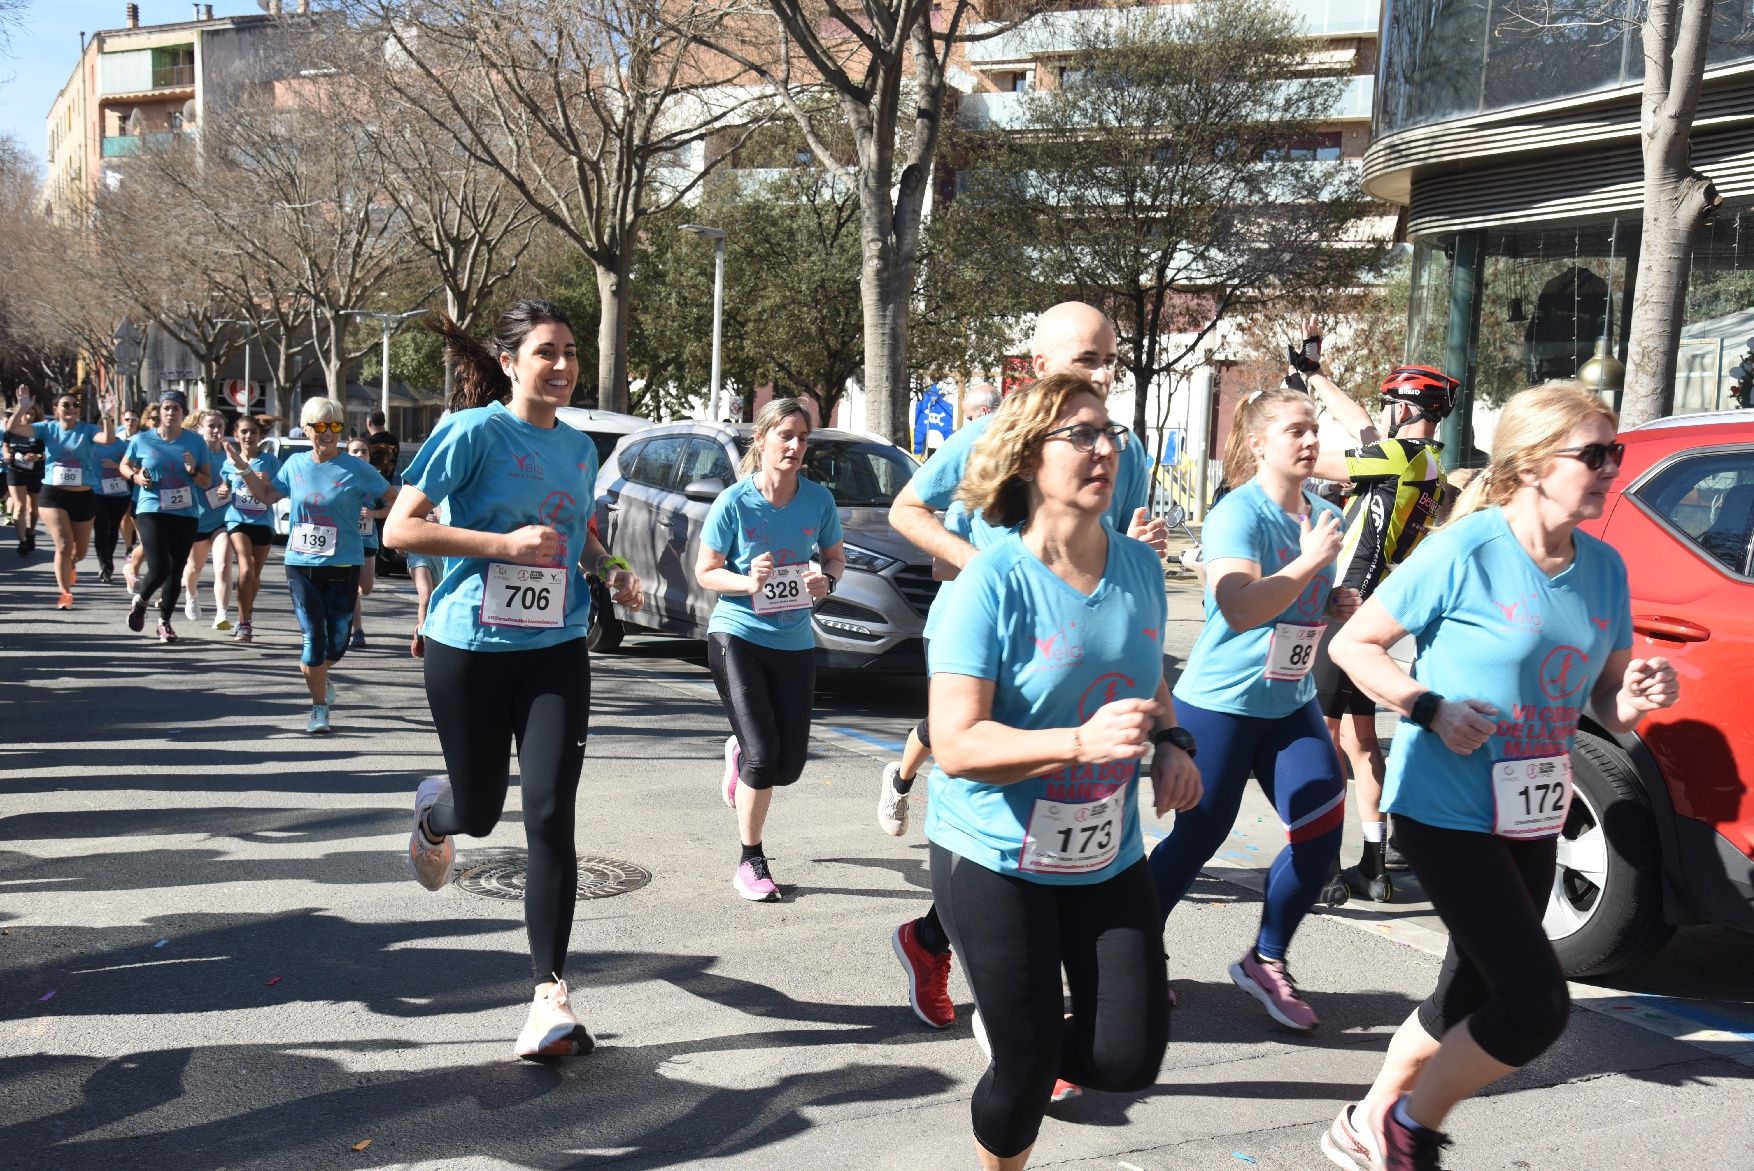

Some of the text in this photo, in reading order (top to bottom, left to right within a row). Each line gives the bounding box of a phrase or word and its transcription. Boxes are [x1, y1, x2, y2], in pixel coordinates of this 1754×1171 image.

[171, 494, 184, 505] 22
[302, 533, 326, 548] 139
[505, 584, 551, 611] 706
[764, 580, 800, 600] 328
[1290, 643, 1312, 665] 88
[1518, 781, 1564, 815] 172
[1057, 819, 1113, 853] 173
